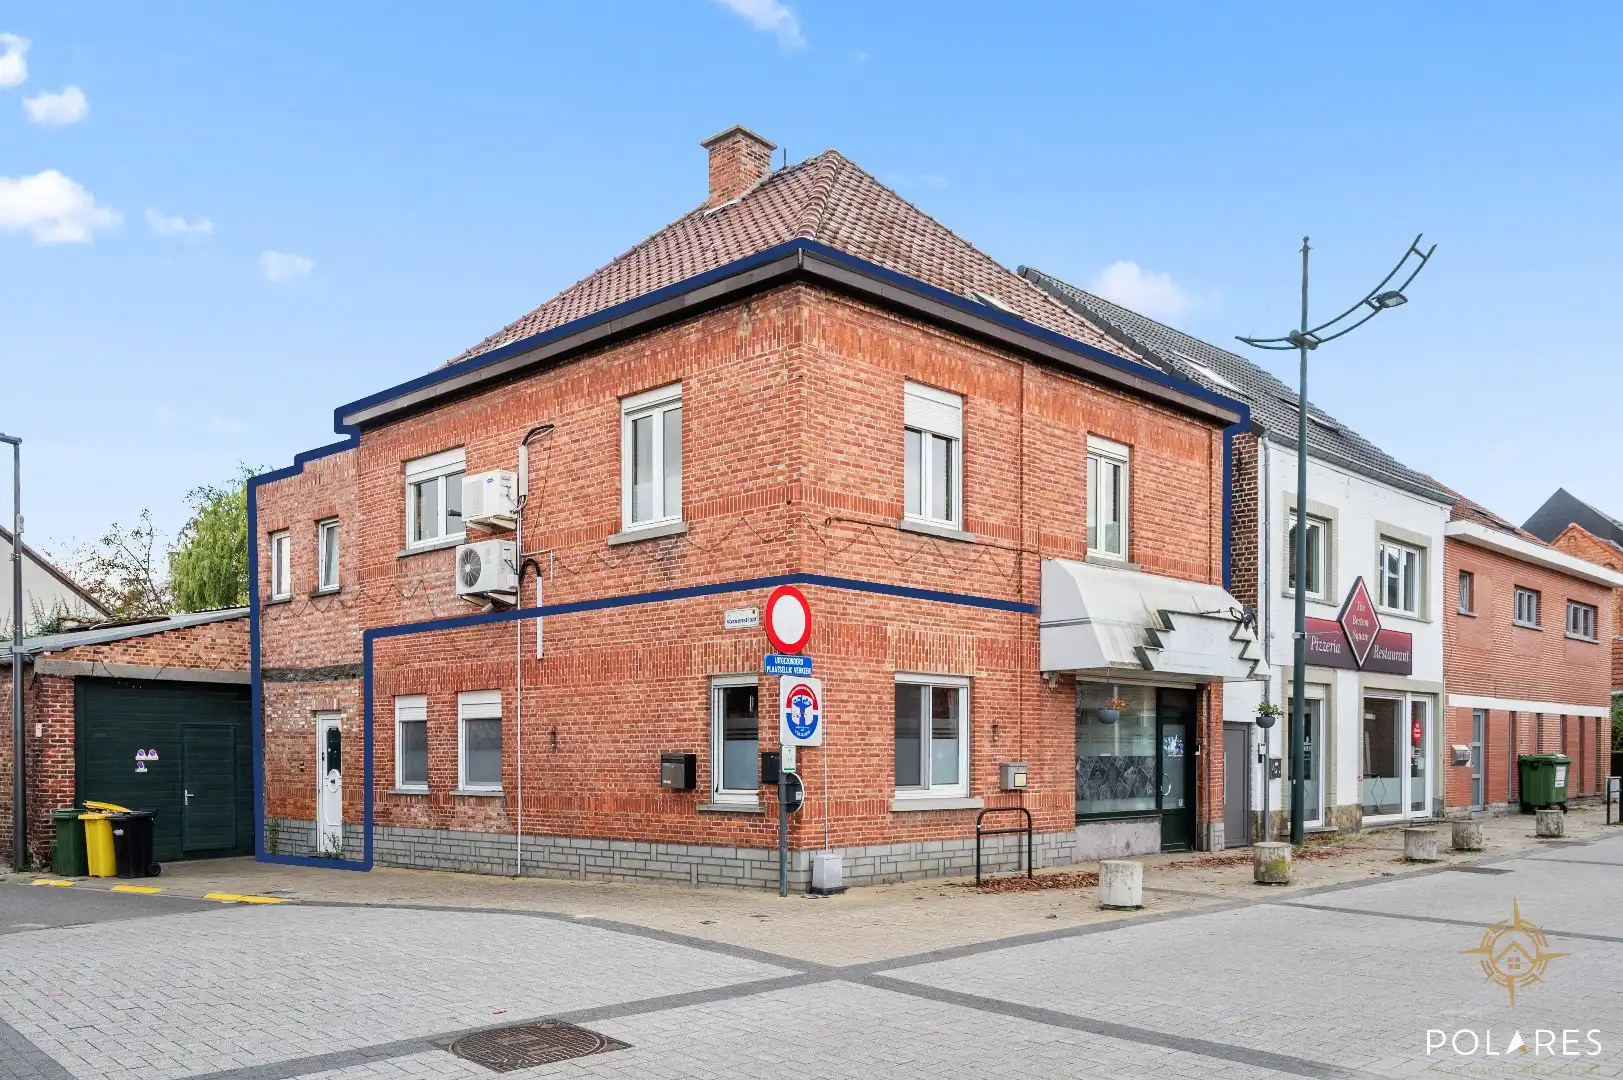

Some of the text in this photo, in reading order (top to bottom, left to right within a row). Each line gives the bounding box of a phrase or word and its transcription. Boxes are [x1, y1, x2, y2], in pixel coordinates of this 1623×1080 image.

[1310, 635, 1341, 654] Pizzeria
[1373, 644, 1410, 662] Restaurant
[766, 665, 812, 675] PLAATSELIJK VERKEER
